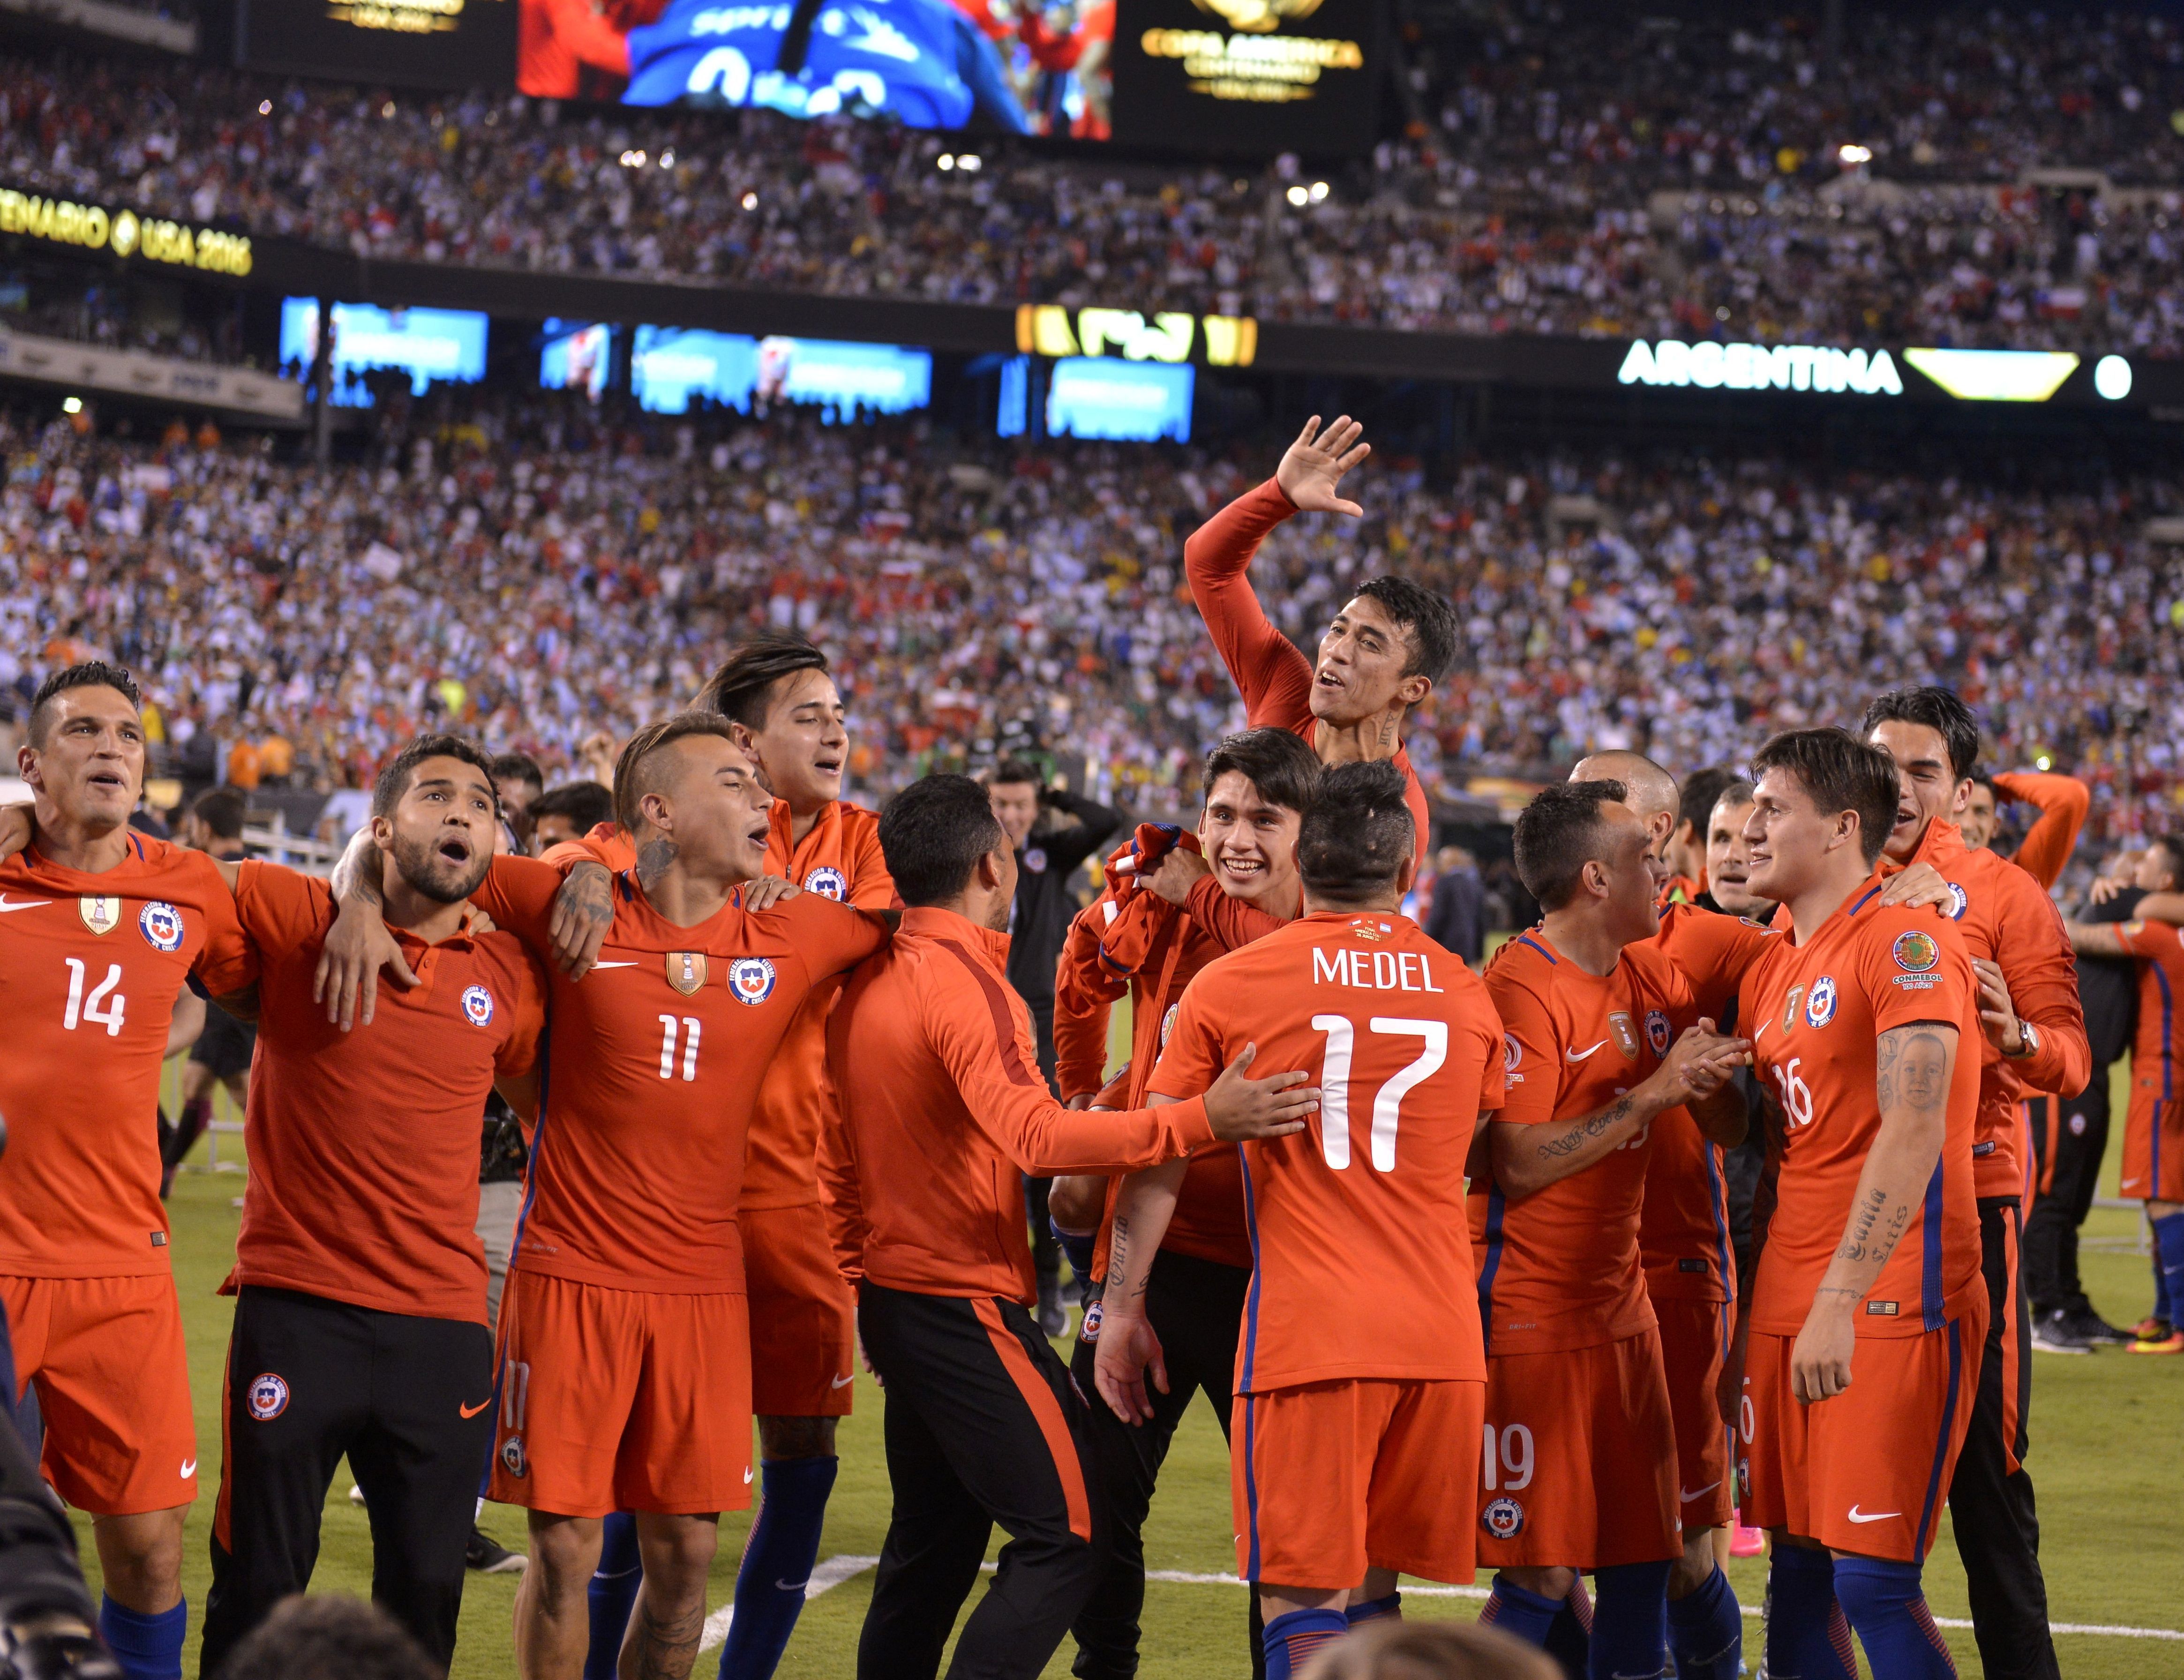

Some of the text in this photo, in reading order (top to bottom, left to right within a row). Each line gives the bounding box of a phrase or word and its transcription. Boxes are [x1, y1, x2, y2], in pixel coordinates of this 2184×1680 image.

[0, 189, 253, 277] ENARIO USA 2016
[1617, 339, 2132, 399] ARGENTINA 0
[804, 868, 825, 891] EDERACION
[63, 957, 125, 1036] 14
[751, 995, 765, 1005] CHILE
[761, 959, 775, 979] FUTBOL
[1313, 947, 1444, 993] MEDEL
[1893, 974, 1942, 984] CONMEBOL
[659, 1014, 700, 1081] 11
[1818, 1015, 1831, 1027] CHILE
[1311, 1014, 1448, 1172] 17
[1772, 1058, 1813, 1129] 16
[1838, 1189, 1886, 1261] Tania
[506, 1360, 529, 1430] 11
[1484, 1424, 1534, 1490] 19
